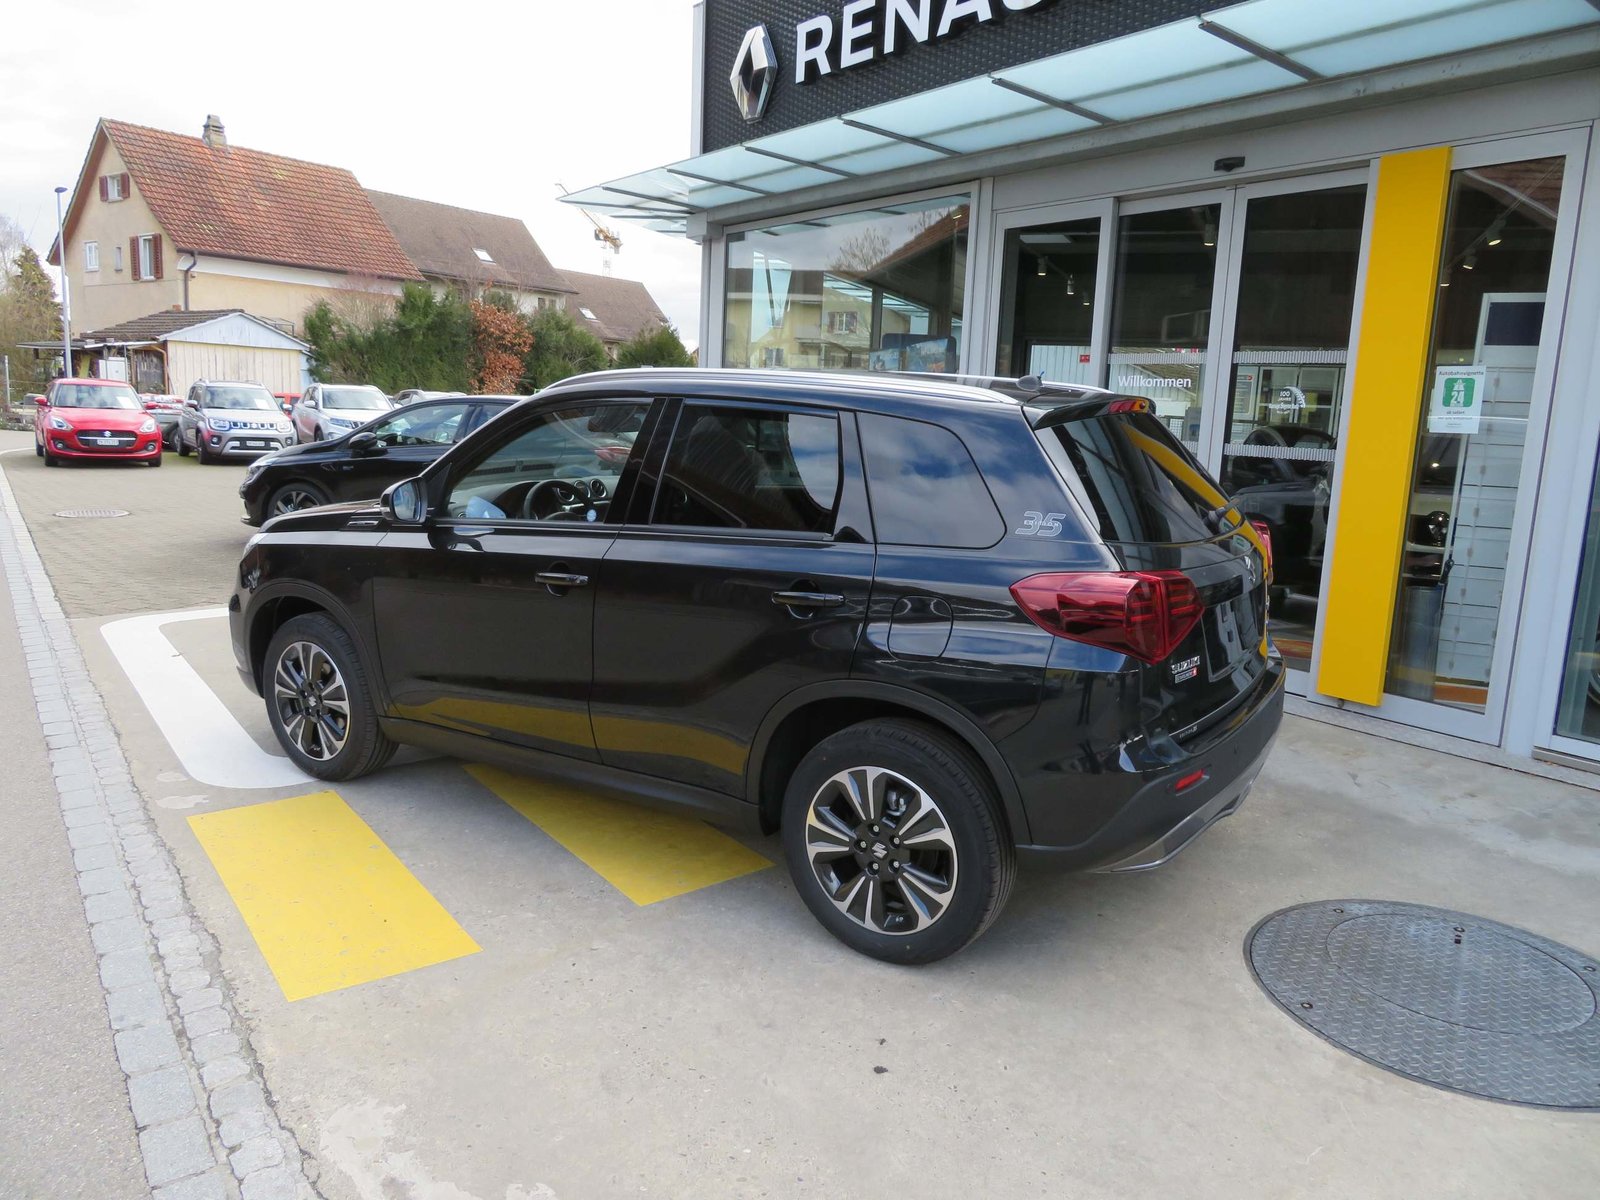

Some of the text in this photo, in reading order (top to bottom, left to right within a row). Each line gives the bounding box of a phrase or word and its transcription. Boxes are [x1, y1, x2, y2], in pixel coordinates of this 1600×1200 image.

[795, 0, 1045, 84] RENA
[1117, 375, 1193, 388] Willkommen
[1014, 510, 1067, 537] 35
[1171, 656, 1200, 674] SUZUKI
